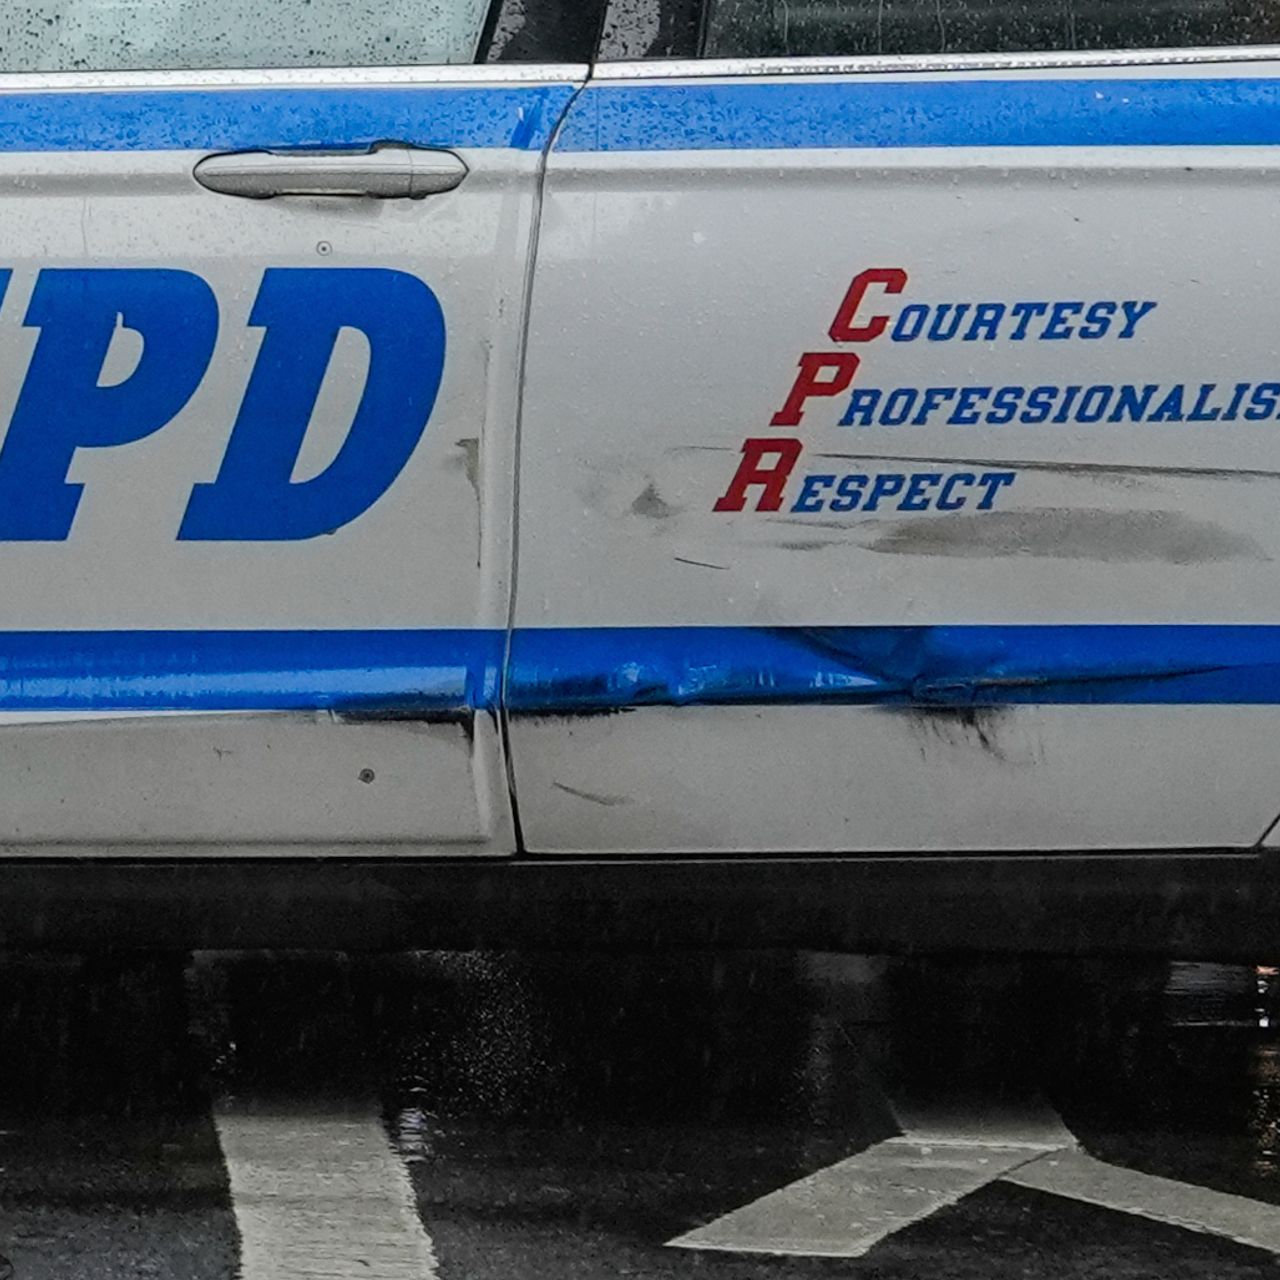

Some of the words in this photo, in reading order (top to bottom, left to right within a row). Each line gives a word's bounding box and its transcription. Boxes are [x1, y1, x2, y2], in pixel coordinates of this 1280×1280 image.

[828, 267, 1157, 343] COURTESY
[769, 352, 1280, 427] PROFESSIONALIS
[713, 437, 1017, 513] RESPECT
